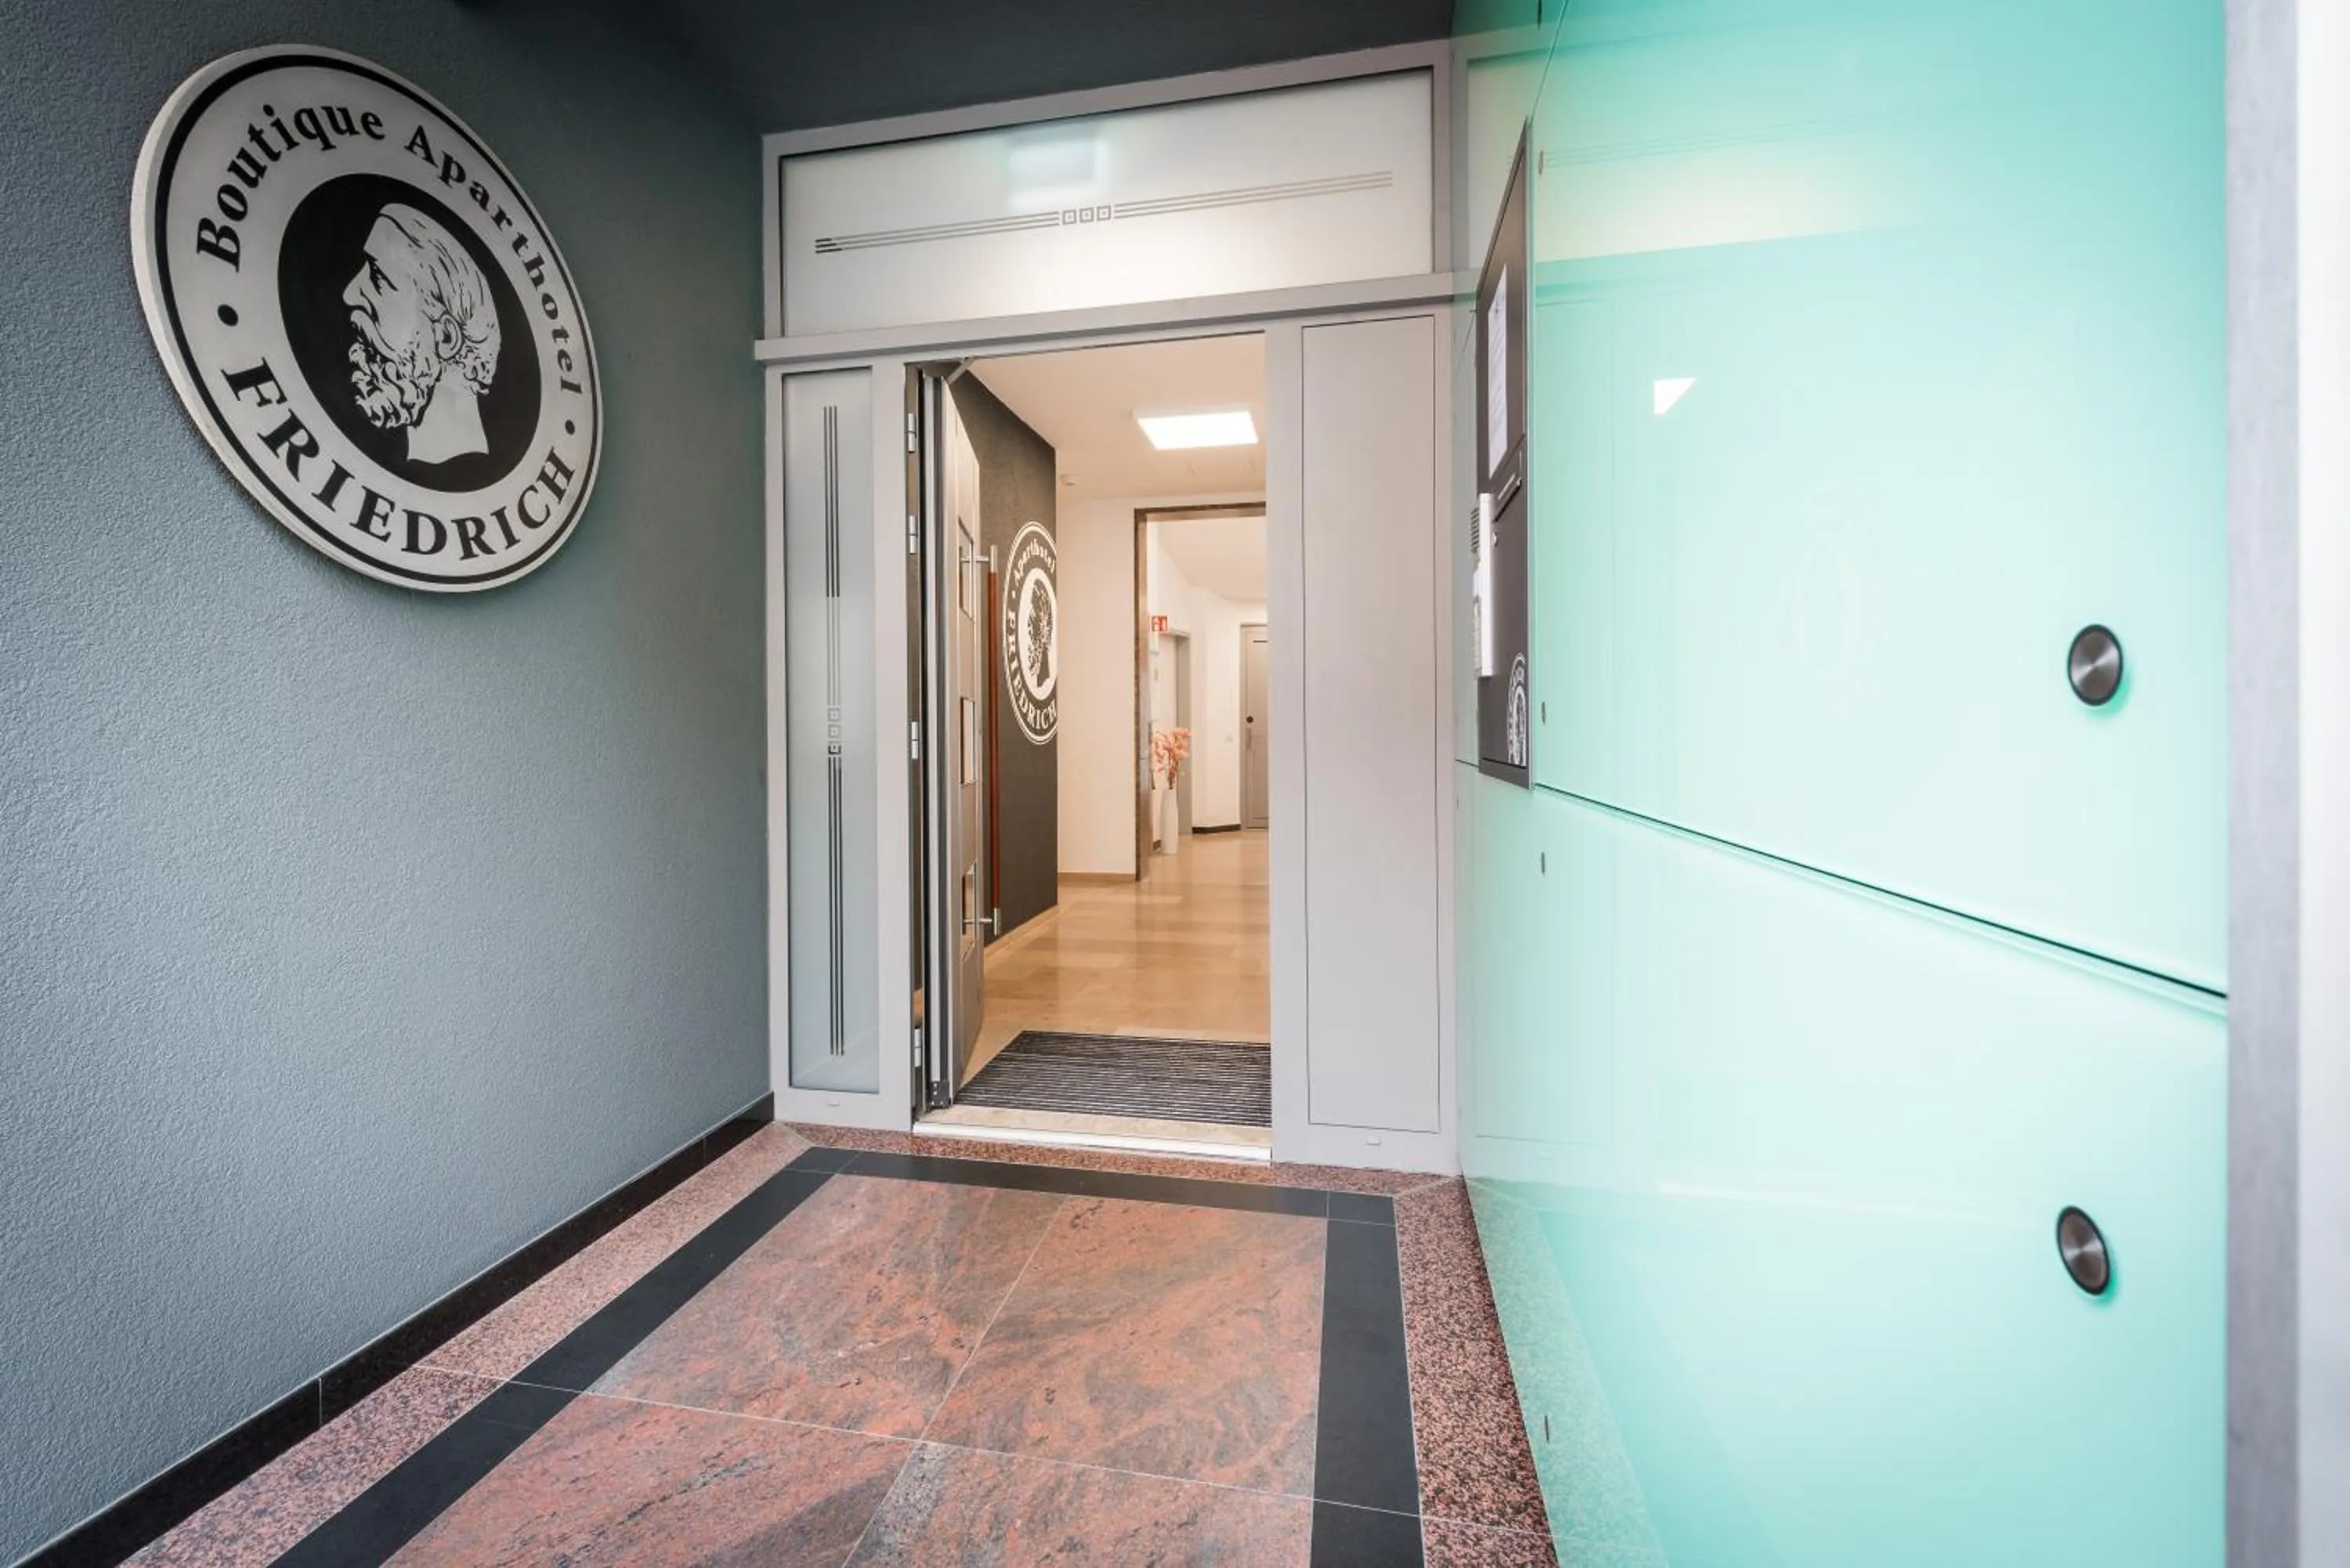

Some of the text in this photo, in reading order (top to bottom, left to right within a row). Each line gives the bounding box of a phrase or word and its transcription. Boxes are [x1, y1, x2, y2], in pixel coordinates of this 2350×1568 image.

[196, 103, 583, 396] Boutique Aparthotel
[220, 356, 577, 561] FRIEDRICH
